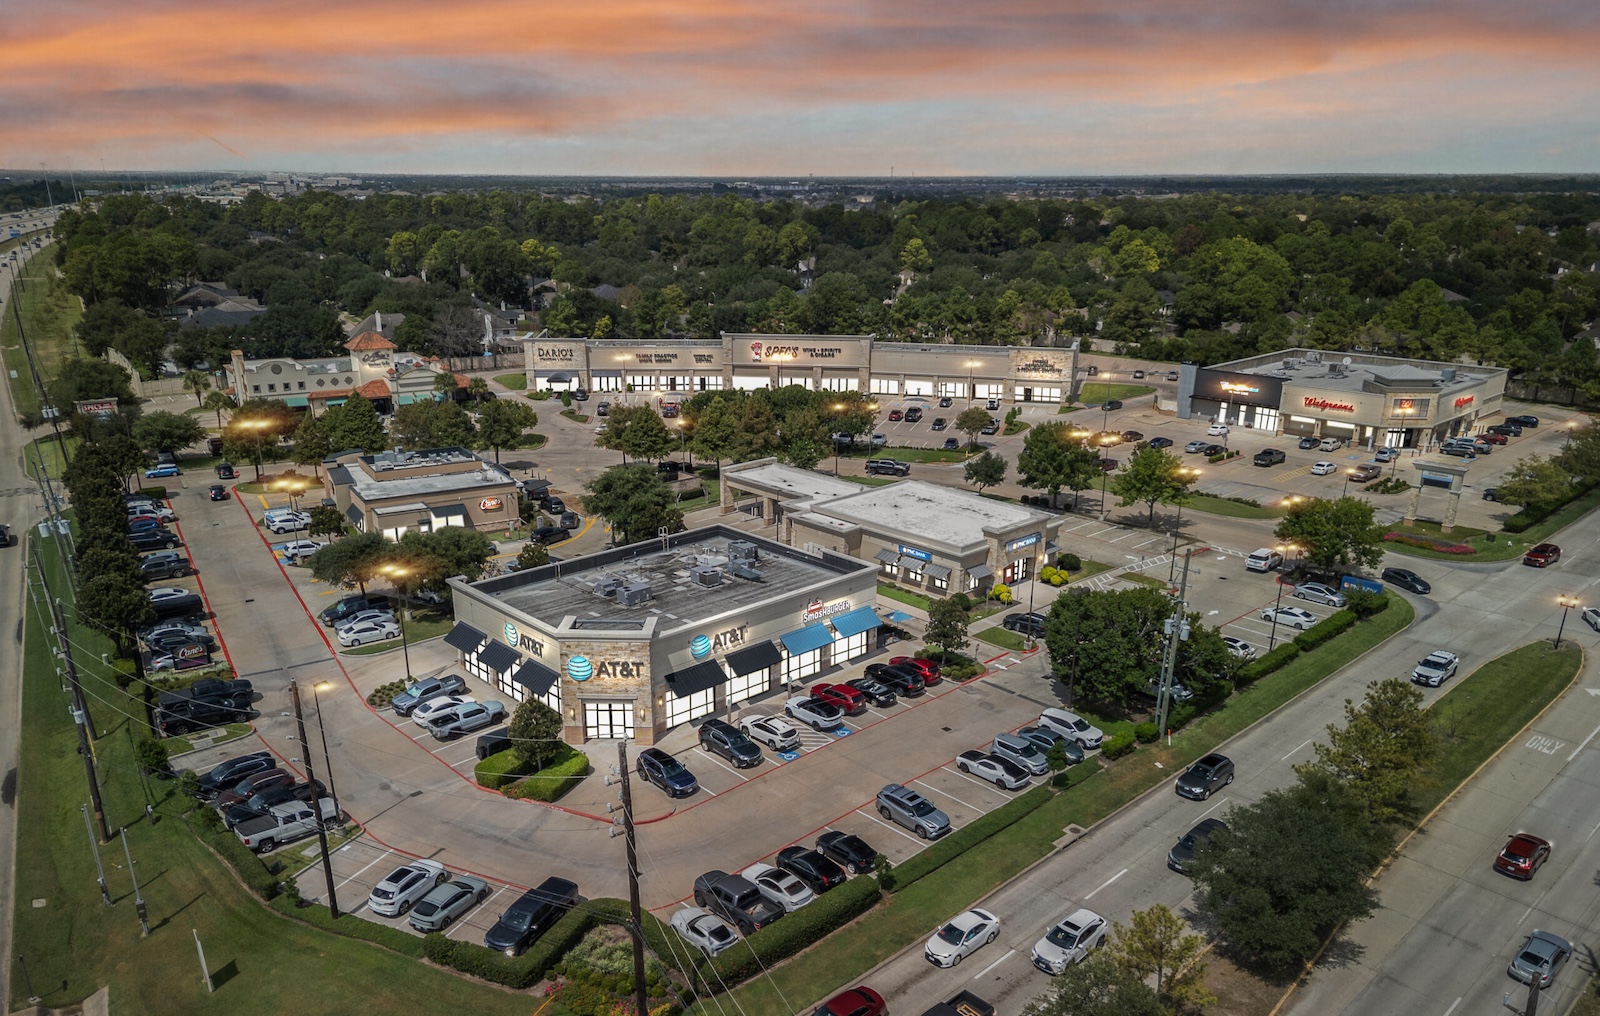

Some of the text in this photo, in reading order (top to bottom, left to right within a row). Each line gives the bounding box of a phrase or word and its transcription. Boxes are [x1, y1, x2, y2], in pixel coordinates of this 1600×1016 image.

[538, 347, 574, 358] DARIO'S
[1304, 397, 1355, 413] Walgreens
[520, 633, 544, 659] AT&T
[713, 624, 747, 651] AT&T
[596, 660, 644, 679] AT&T
[1524, 735, 1566, 756] ONLY
